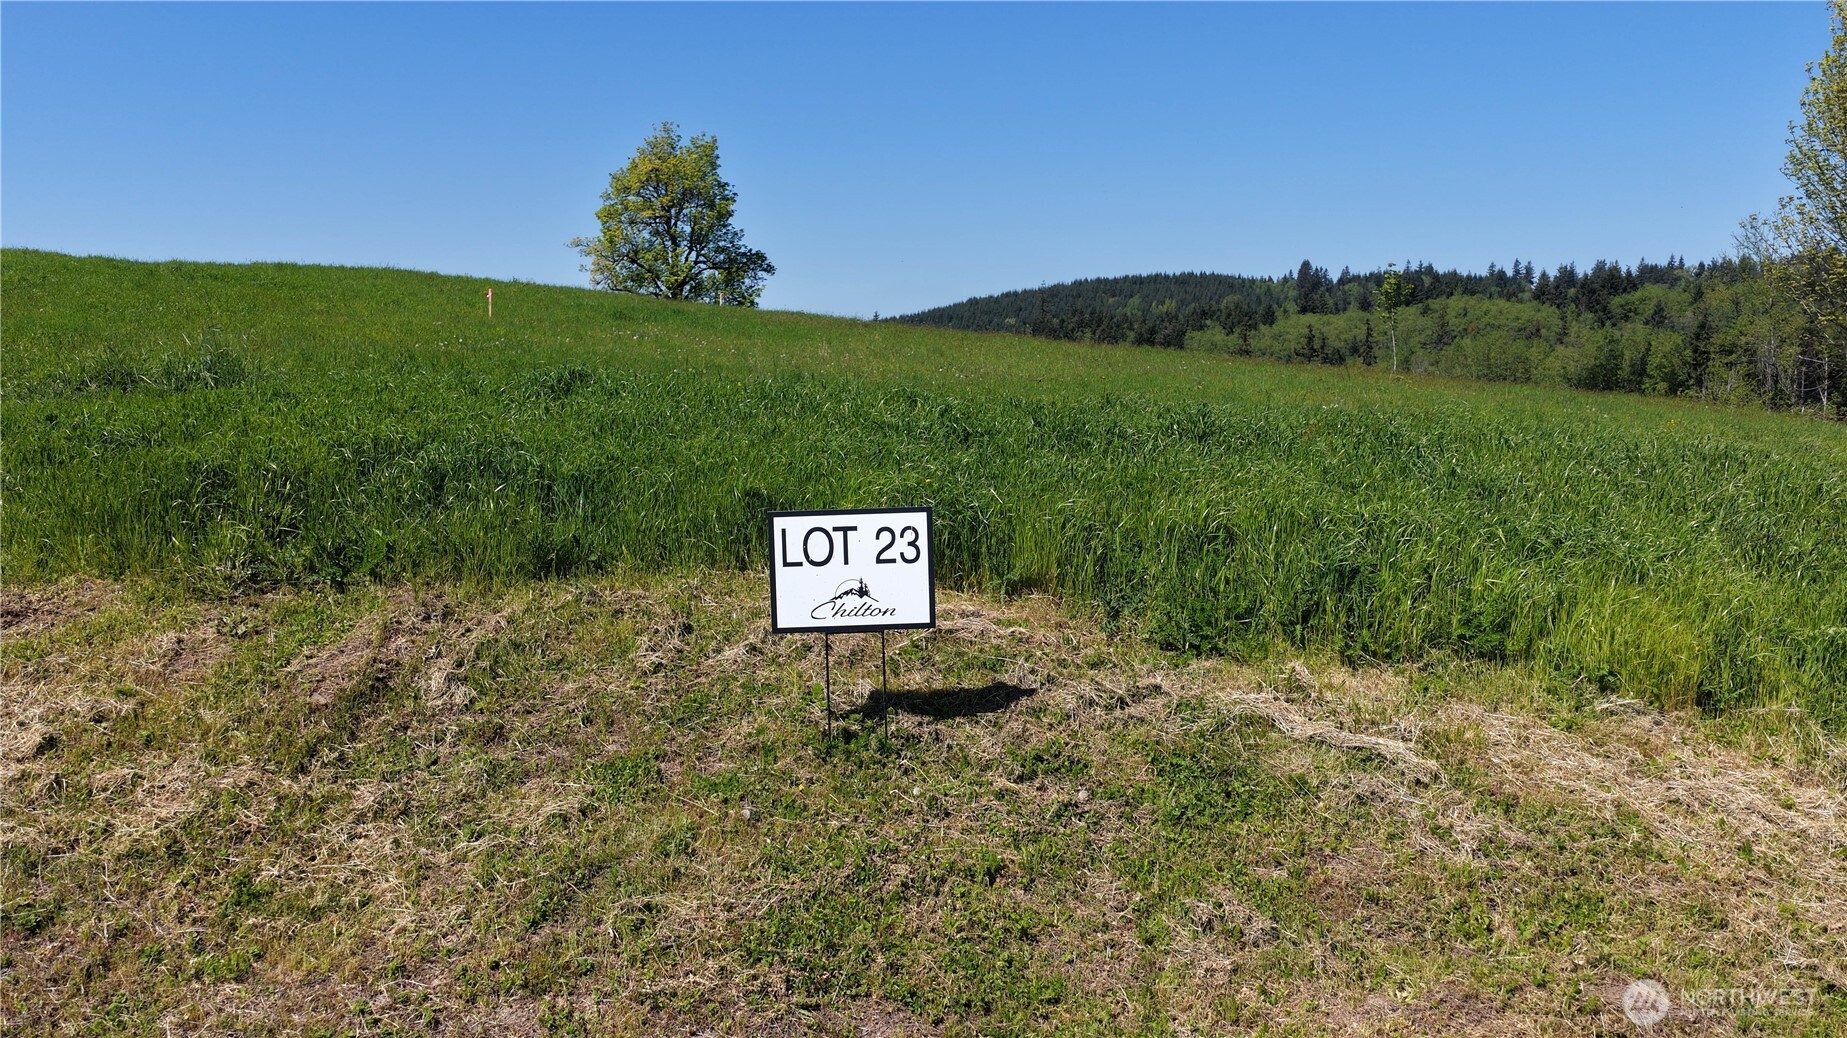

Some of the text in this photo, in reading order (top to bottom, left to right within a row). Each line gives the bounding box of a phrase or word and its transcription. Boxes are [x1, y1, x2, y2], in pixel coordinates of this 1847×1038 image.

[781, 525, 921, 567] LOT 23
[810, 601, 896, 620] Chilton
